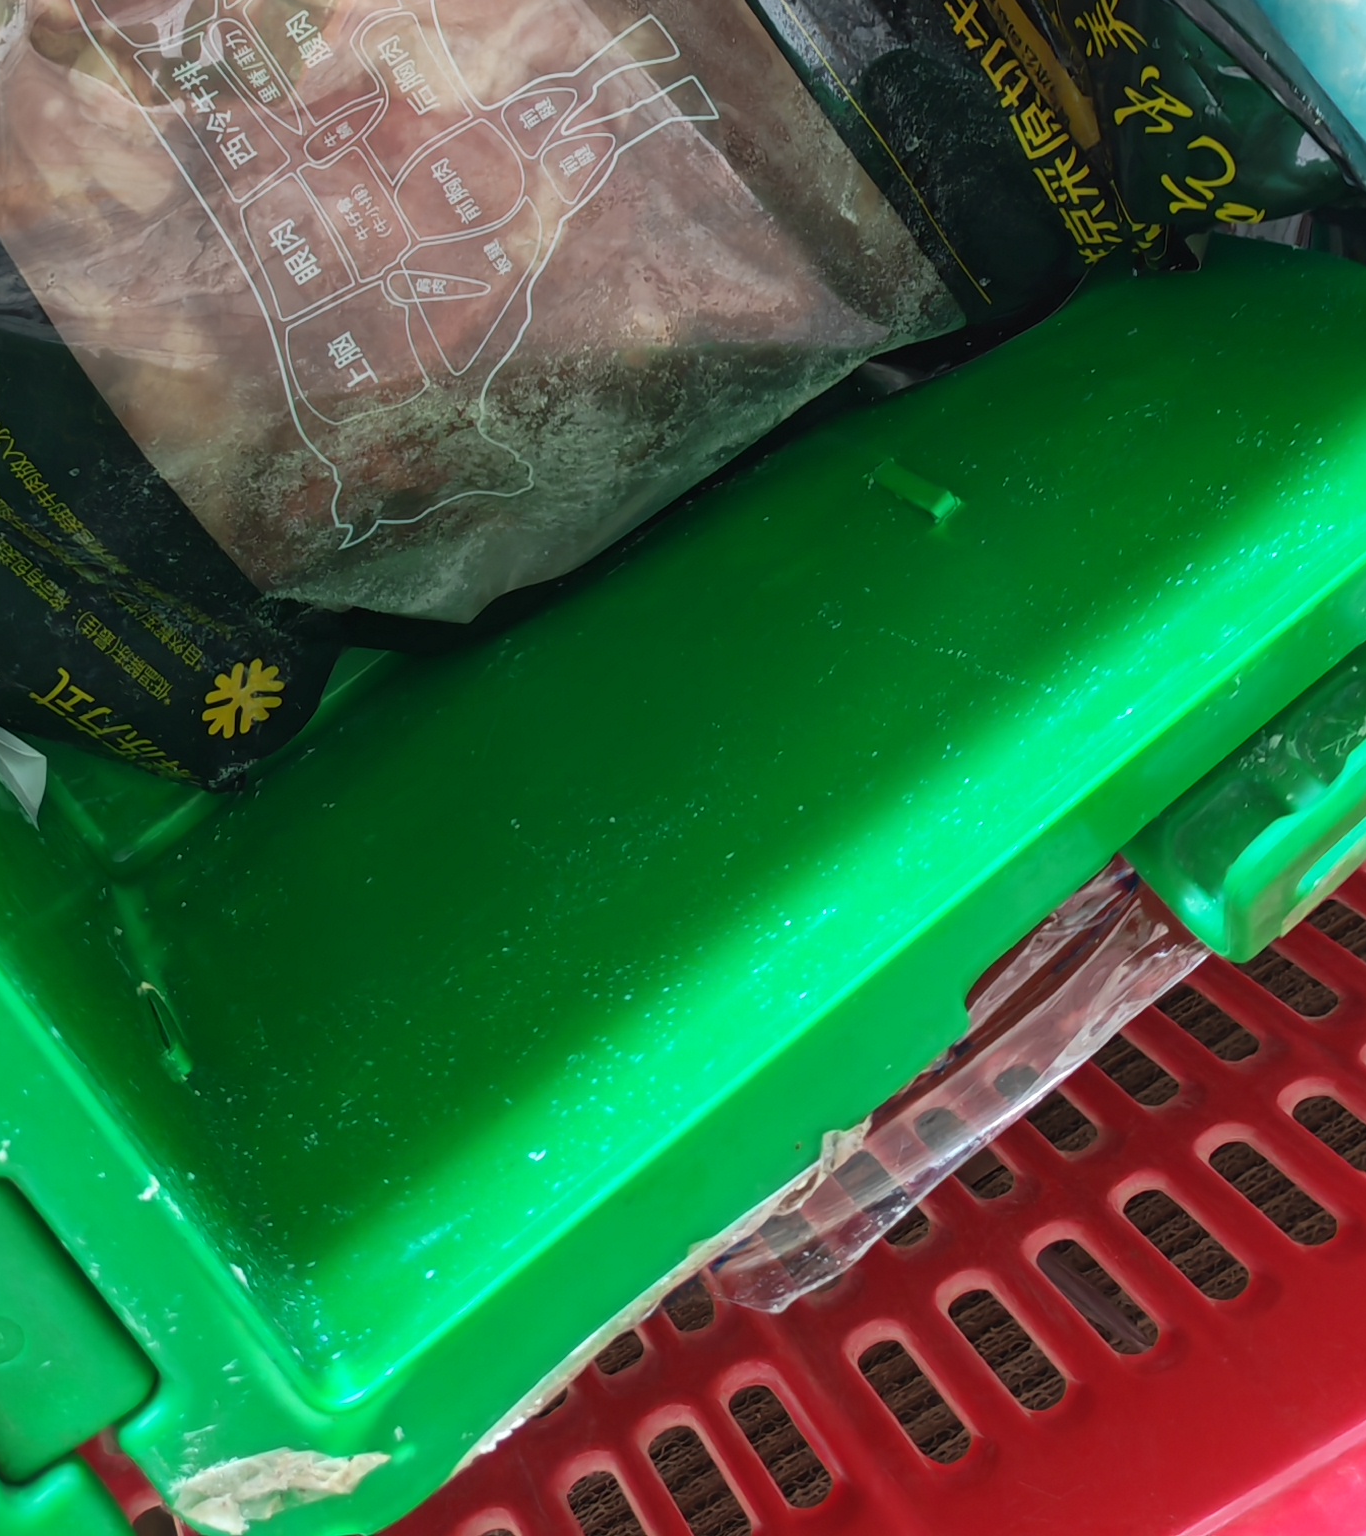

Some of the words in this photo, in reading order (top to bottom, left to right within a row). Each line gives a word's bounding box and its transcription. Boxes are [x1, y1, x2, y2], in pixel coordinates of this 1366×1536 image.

[225, 23, 280, 109] 里脊/菲力
[285, 10, 333, 68] 腹肉
[377, 35, 440, 116] 后胸肉
[172, 58, 257, 169] 西冷牛排
[430, 158, 481, 224] 前胸肉
[268, 219, 321, 285] 眼肉
[327, 331, 379, 392] 上脑
